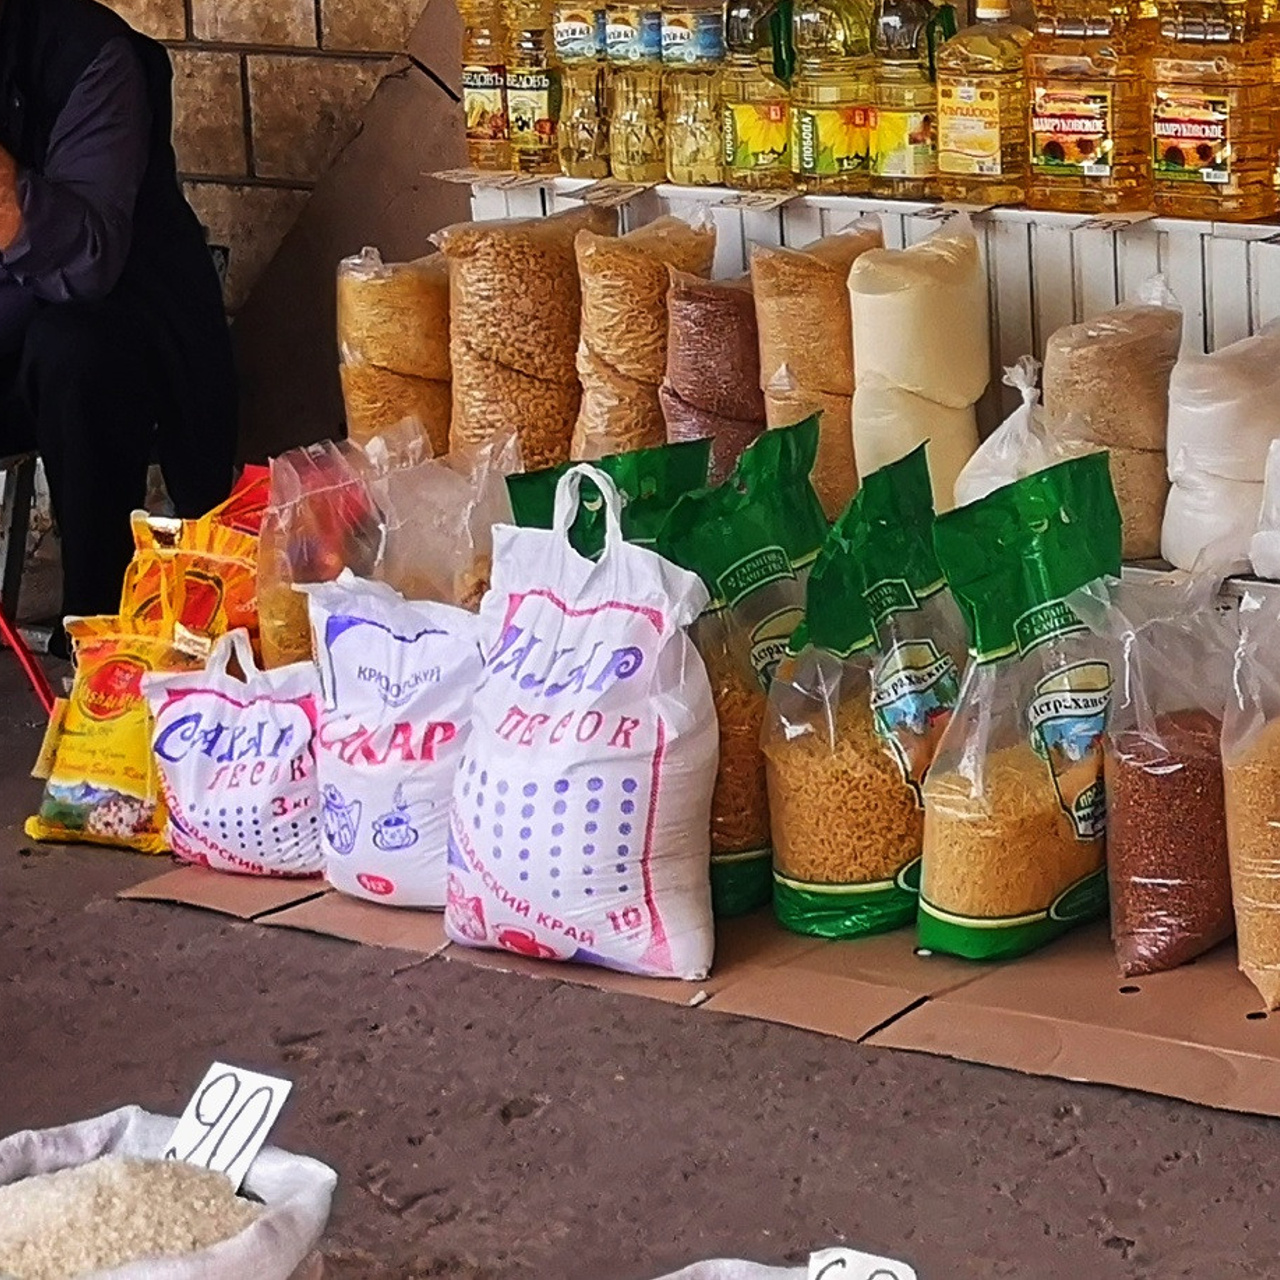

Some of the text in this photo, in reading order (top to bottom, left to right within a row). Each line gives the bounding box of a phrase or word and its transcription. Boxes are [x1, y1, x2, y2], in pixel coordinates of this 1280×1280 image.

[801, 114, 815, 169] СЛОБОДА
[495, 705, 640, 749] ПЕСОК
[270, 795, 311, 817] 3 кг
[536, 911, 595, 947] КРАЙ
[606, 906, 643, 934] 10
[164, 1072, 274, 1174] 90
